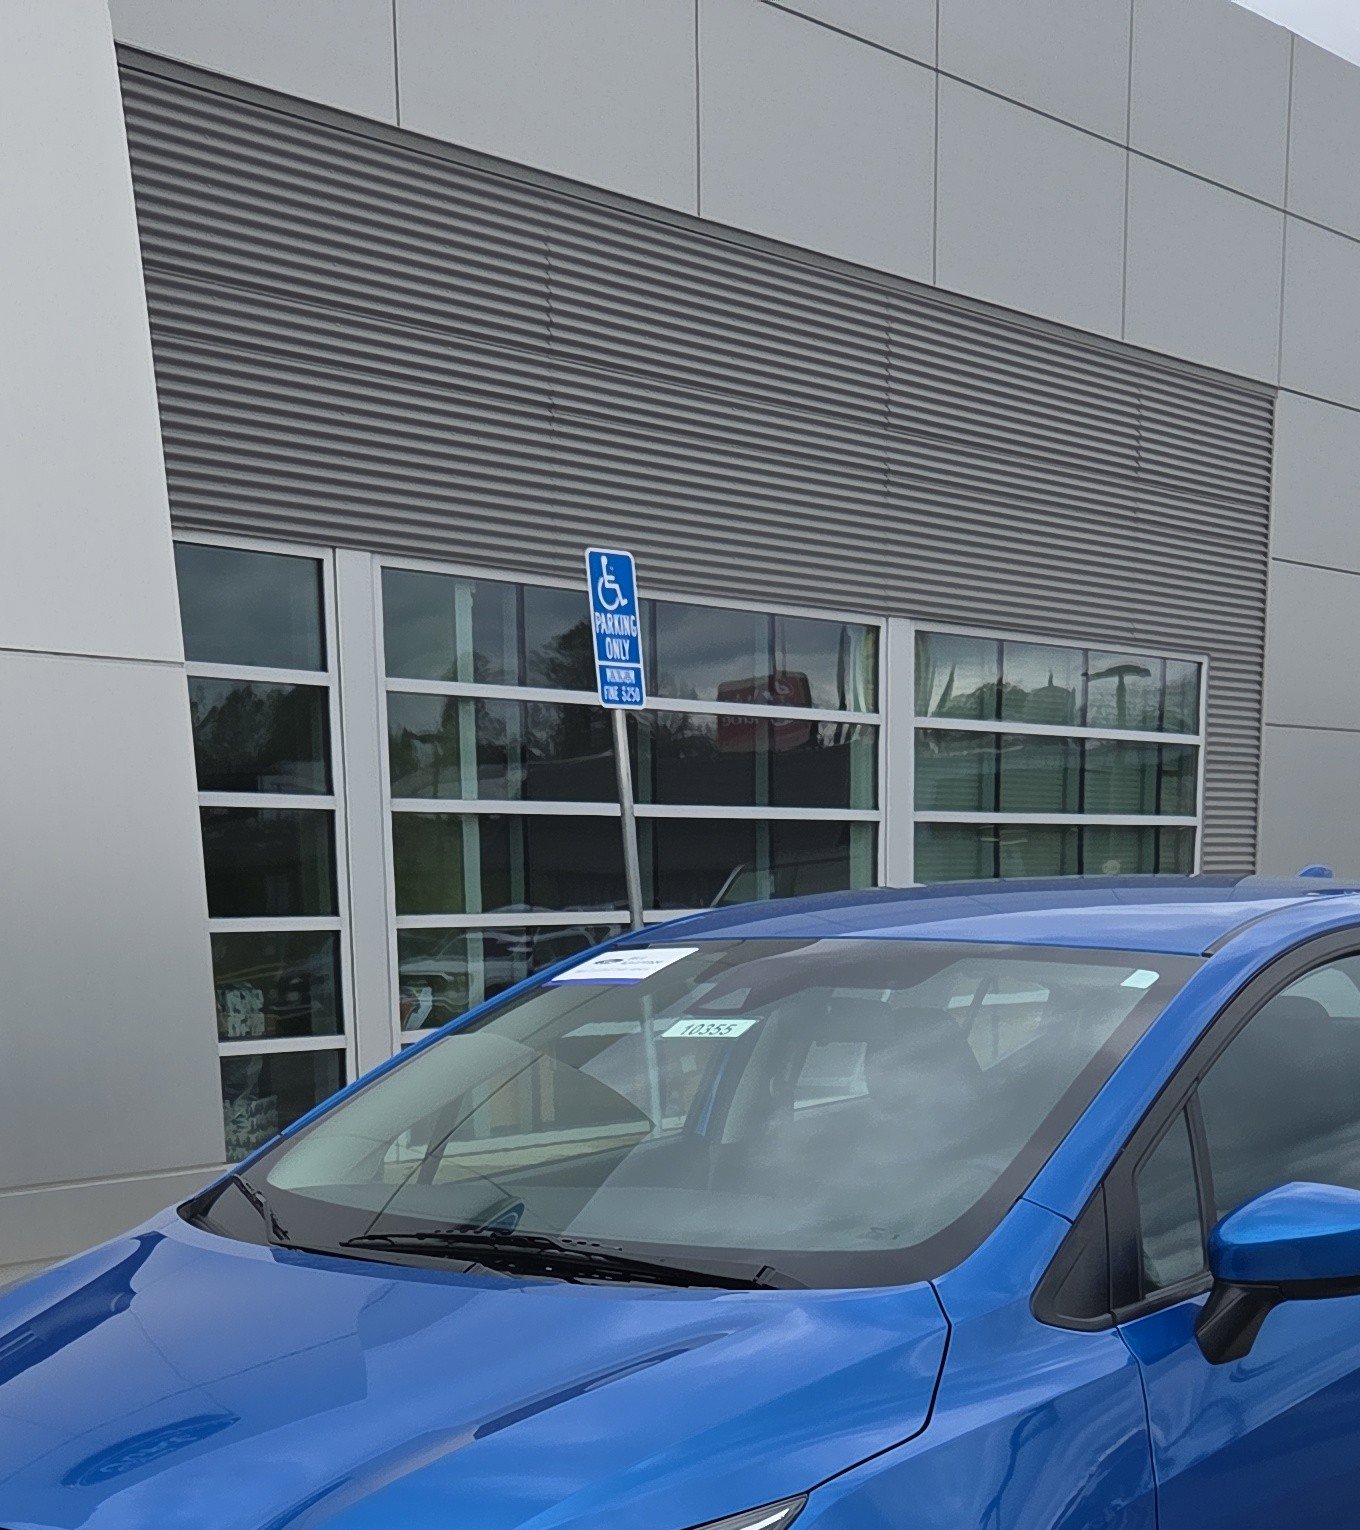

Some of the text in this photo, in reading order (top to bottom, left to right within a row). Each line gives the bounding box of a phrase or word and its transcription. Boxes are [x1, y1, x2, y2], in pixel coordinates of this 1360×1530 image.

[595, 612, 638, 637] PARKING
[605, 637, 630, 660] ONLY
[603, 685, 619, 701] FINE
[680, 1023, 738, 1036] 10355
